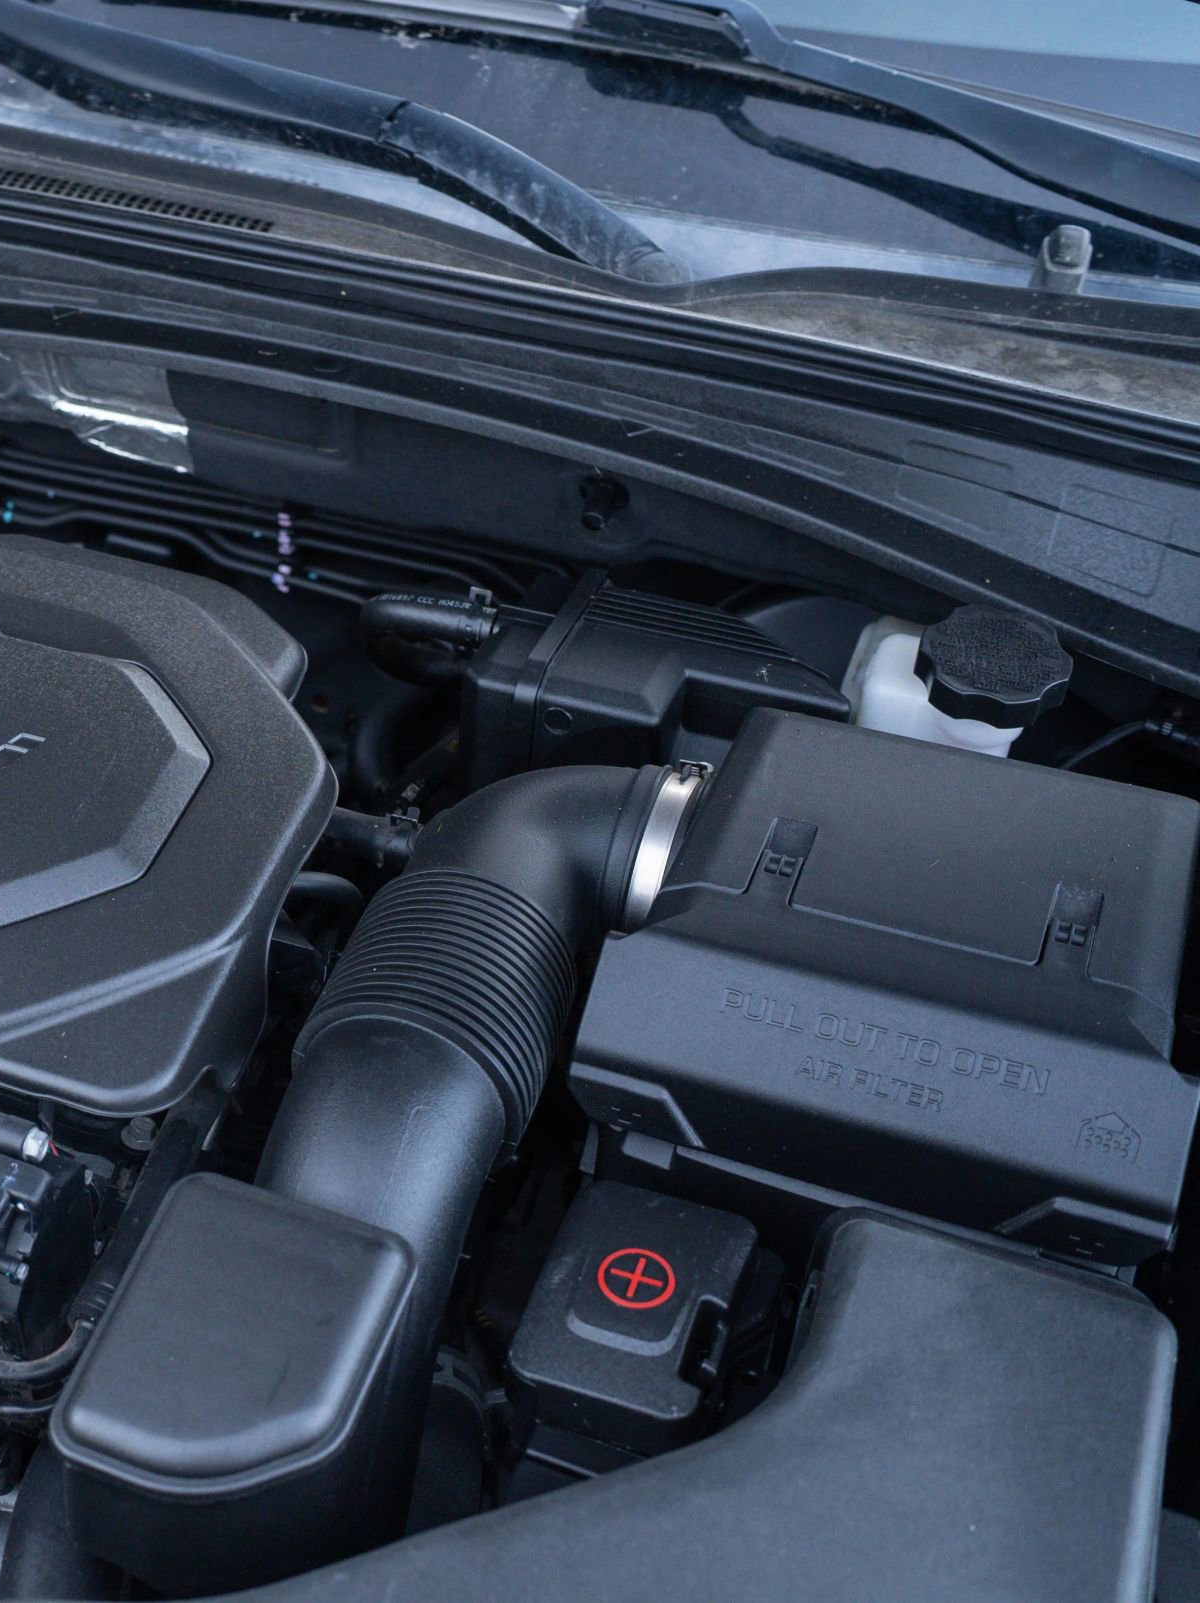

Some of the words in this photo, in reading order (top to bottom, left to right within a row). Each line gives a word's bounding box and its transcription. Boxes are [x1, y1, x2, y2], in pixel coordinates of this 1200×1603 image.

[719, 987, 804, 1033] PULL
[815, 1012, 888, 1052] OUT
[894, 1031, 942, 1067] TO
[950, 1047, 1051, 1096] OPEN
[795, 1055, 844, 1086] AIR
[850, 1067, 945, 1113] FILTER
